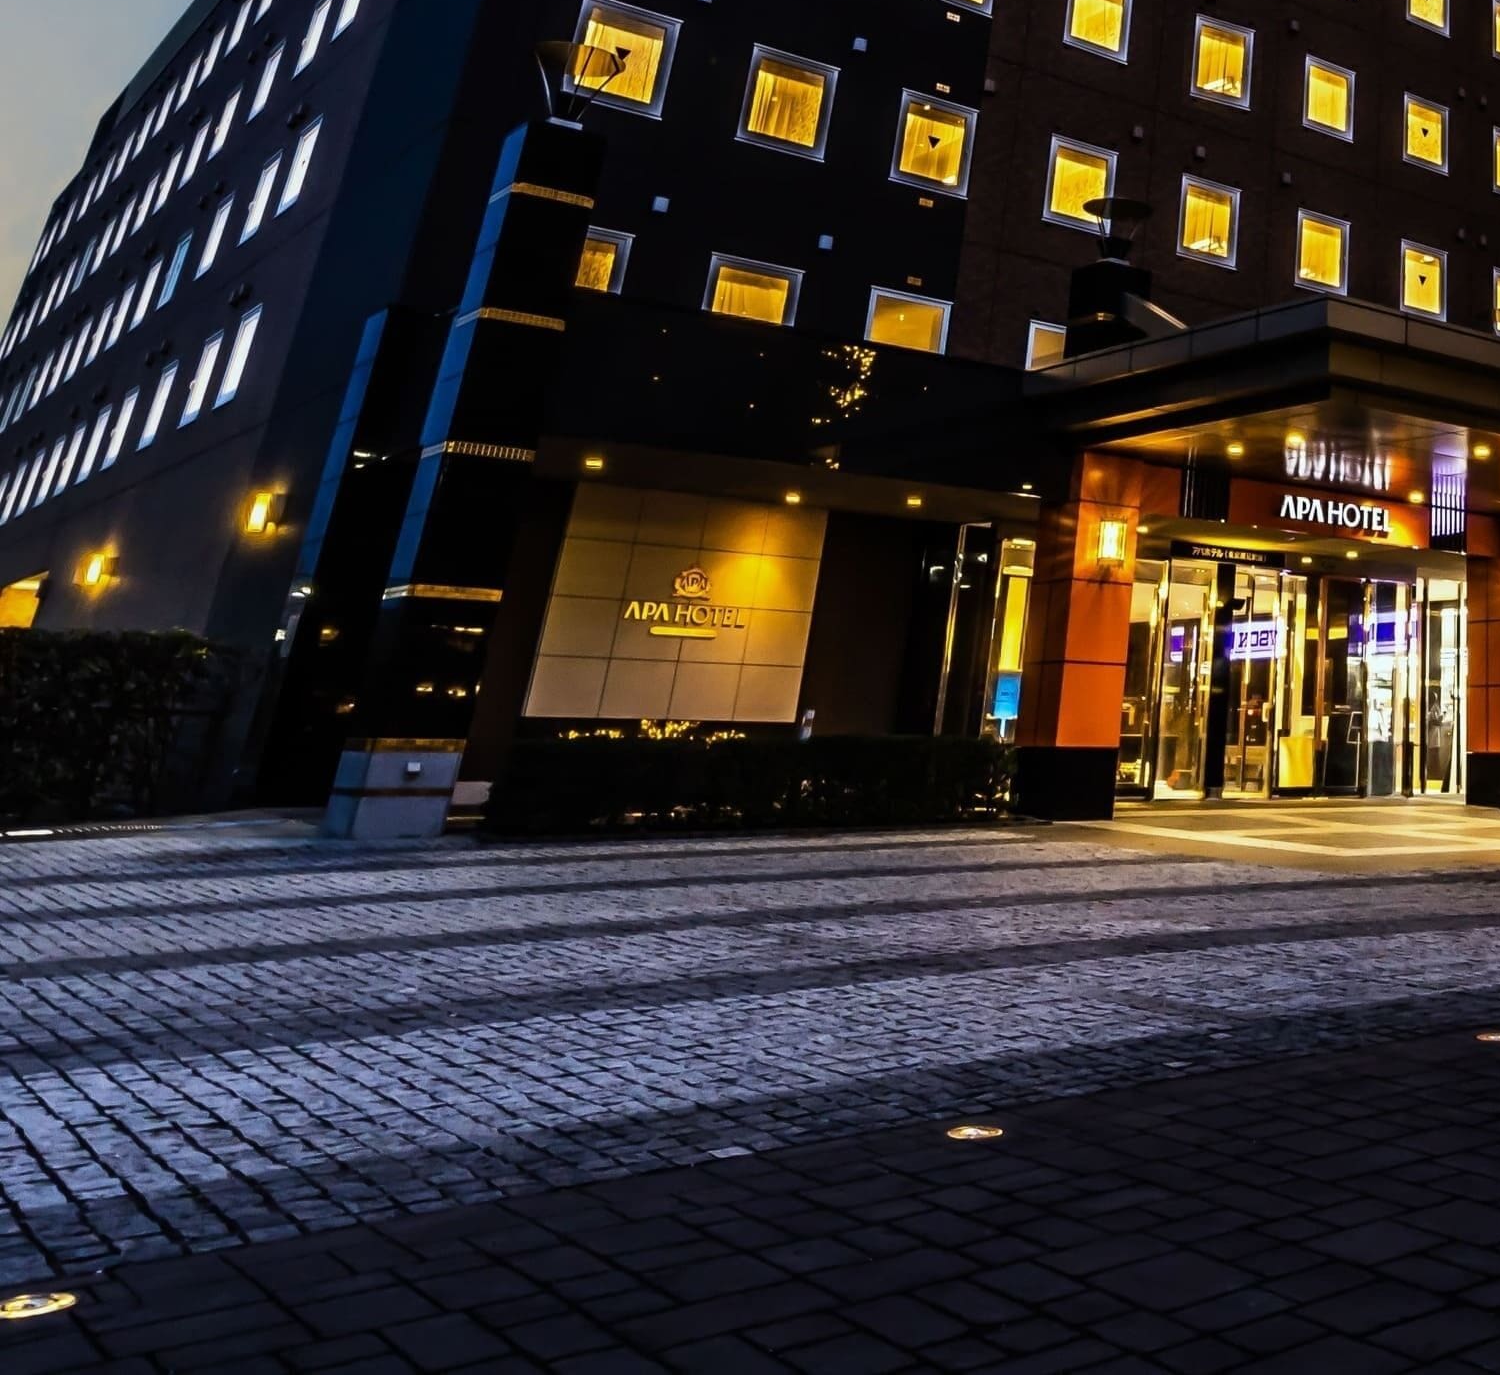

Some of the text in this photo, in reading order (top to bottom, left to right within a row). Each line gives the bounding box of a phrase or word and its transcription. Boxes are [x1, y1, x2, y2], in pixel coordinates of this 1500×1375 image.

[1280, 494, 1393, 532] APA HOTEL
[624, 601, 746, 628] APA HOTEL
